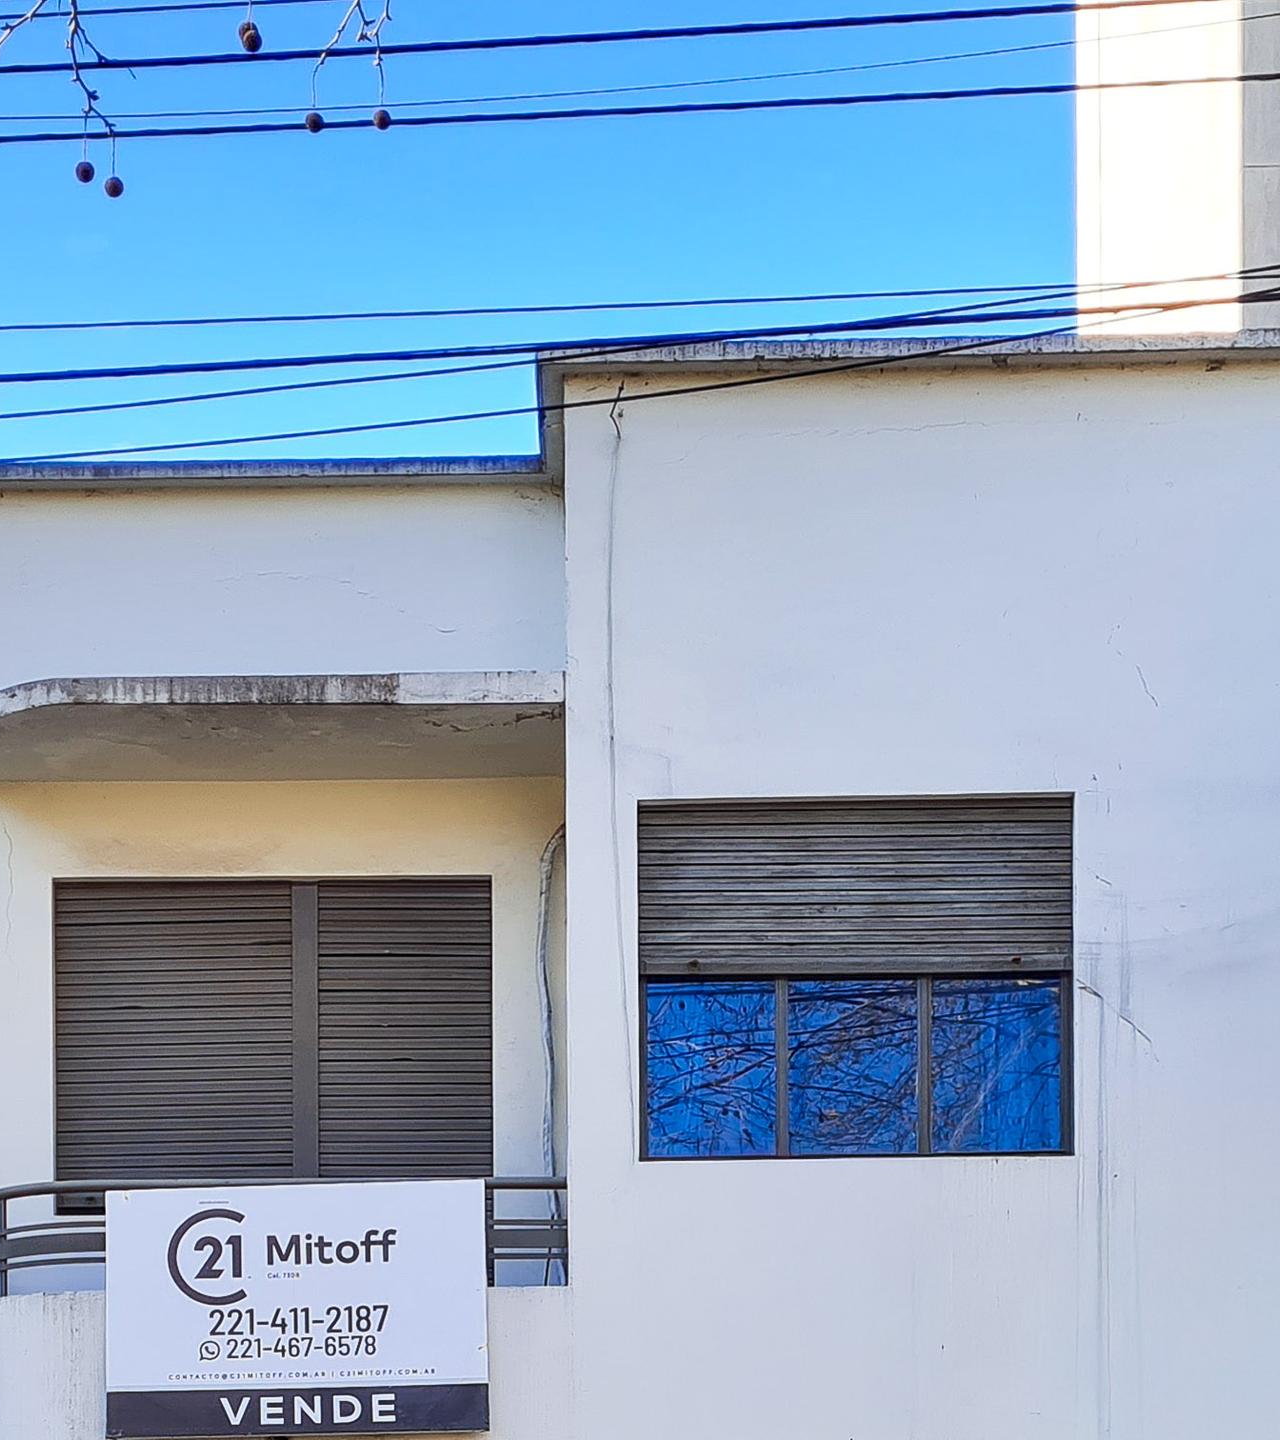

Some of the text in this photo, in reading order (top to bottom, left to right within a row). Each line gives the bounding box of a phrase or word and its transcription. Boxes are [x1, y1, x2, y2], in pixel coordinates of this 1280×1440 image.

[266, 1228, 397, 1266] Mitoff
[208, 1304, 389, 1336] 221-411-2187
[226, 1335, 376, 1359] 221-467-6578
[220, 1393, 397, 1426] VENDE
